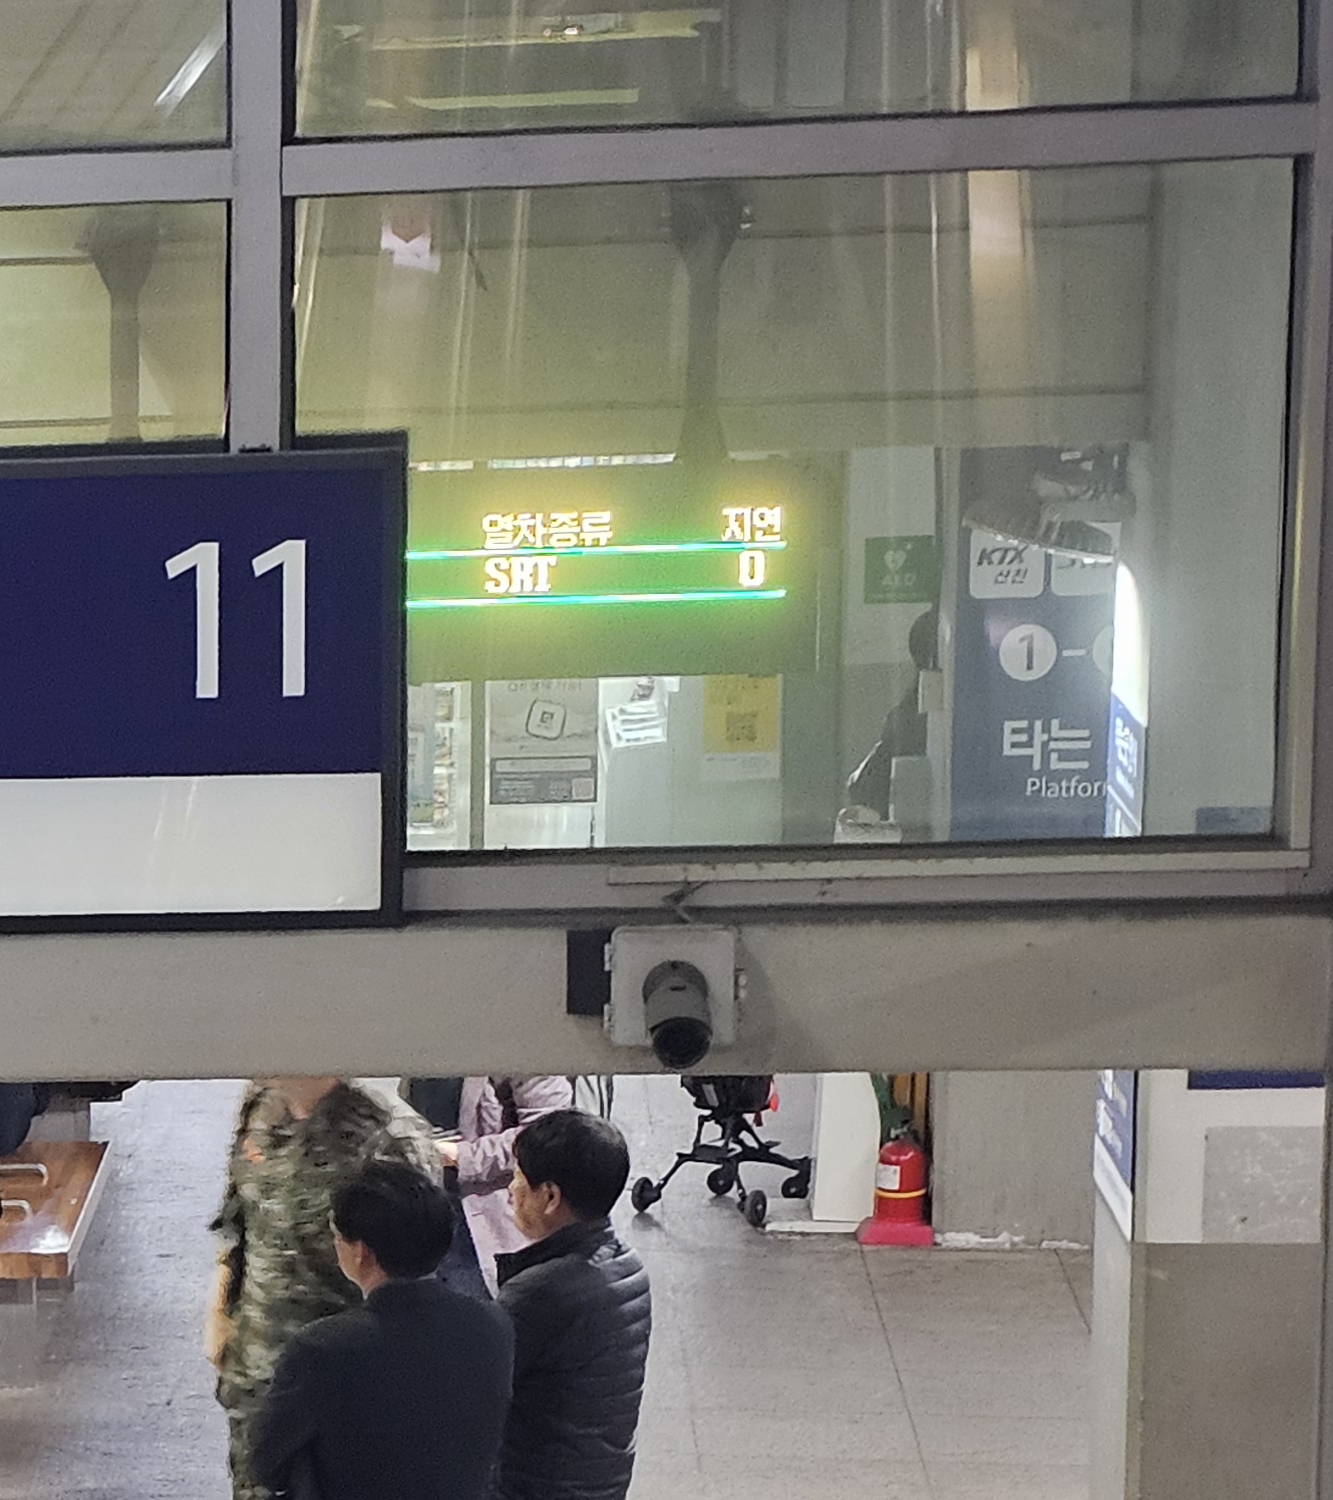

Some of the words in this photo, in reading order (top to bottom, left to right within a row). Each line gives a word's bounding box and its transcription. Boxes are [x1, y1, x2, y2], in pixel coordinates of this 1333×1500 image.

[481, 511, 614, 550] 열차종류
[721, 506, 783, 542] 지연
[483, 556, 557, 594] SRT
[739, 550, 766, 588] 0
[165, 539, 307, 699] 11
[1002, 718, 1093, 771] 타는
[1025, 775, 1108, 799] Platfor
